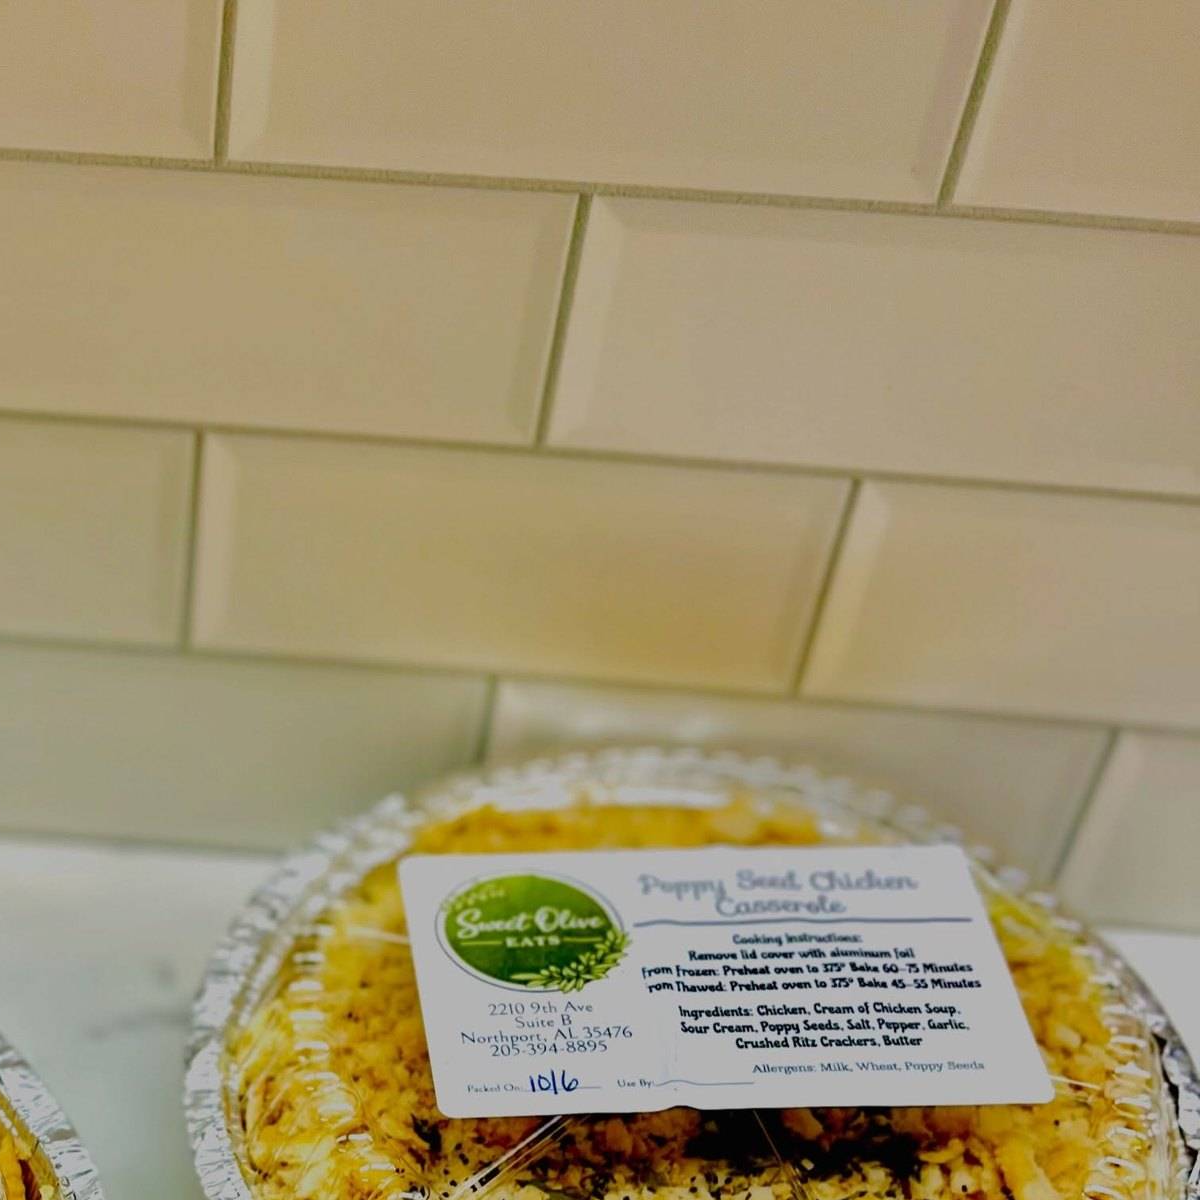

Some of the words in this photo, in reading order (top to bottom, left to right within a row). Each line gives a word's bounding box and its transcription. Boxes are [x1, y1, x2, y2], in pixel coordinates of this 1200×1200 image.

[638, 874, 727, 901] Poppy
[736, 869, 802, 890] Seed
[809, 869, 919, 891] Chicken
[716, 895, 846, 917] Casserole
[456, 908, 535, 939] Sweet
[533, 905, 605, 933] Olive
[504, 935, 561, 948] EATS
[732, 934, 783, 946] Cooking
[785, 932, 863, 944] Instructions:
[688, 950, 737, 961] Remove
[740, 949, 757, 960] lid
[761, 951, 795, 960] cover
[798, 948, 826, 959] with
[830, 948, 892, 959] aluminum
[894, 948, 916, 960] foil
[722, 964, 770, 976] Preheat
[774, 965, 803, 975] oven
[806, 964, 819, 974] to
[850, 962, 880, 973] Bake
[923, 962, 973, 974] Minutes
[646, 981, 673, 994] rom
[675, 980, 727, 992] Thawed:
[730, 980, 778, 992] Preheat
[782, 981, 811, 991] oven
[815, 979, 827, 989] to
[857, 977, 887, 989] Bake
[931, 978, 981, 990] Minutes
[488, 1003, 525, 1016] 2210
[530, 1002, 557, 1015] 9th
[564, 1001, 593, 1013] Ave
[678, 1005, 753, 1021] Ingredients:
[813, 1002, 855, 1015] Cream
[858, 1002, 870, 1015] of
[873, 1002, 922, 1015] Chicken
[515, 1016, 555, 1029] Suite
[561, 1014, 572, 1026] B
[681, 1021, 709, 1034] Sour
[760, 1021, 800, 1035] Poppy
[461, 1030, 548, 1045] Northport,
[554, 1028, 578, 1040] AL
[583, 1025, 633, 1039] 35476
[736, 1037, 789, 1049] Crushed
[792, 1036, 817, 1048] Ritz
[820, 1035, 881, 1048] Crackers,
[882, 1034, 923, 1047] Butter
[491, 1040, 607, 1057] 205-394-8895
[752, 1063, 816, 1075] Allergens:
[820, 1062, 853, 1073] Milk,
[855, 1061, 901, 1072] Wheat,
[904, 1061, 943, 1073] Poppy
[947, 1060, 985, 1071] Seeds
[467, 1084, 500, 1093] Packed
[529, 1069, 579, 1095] 10/6
[617, 1079, 636, 1088] Use
